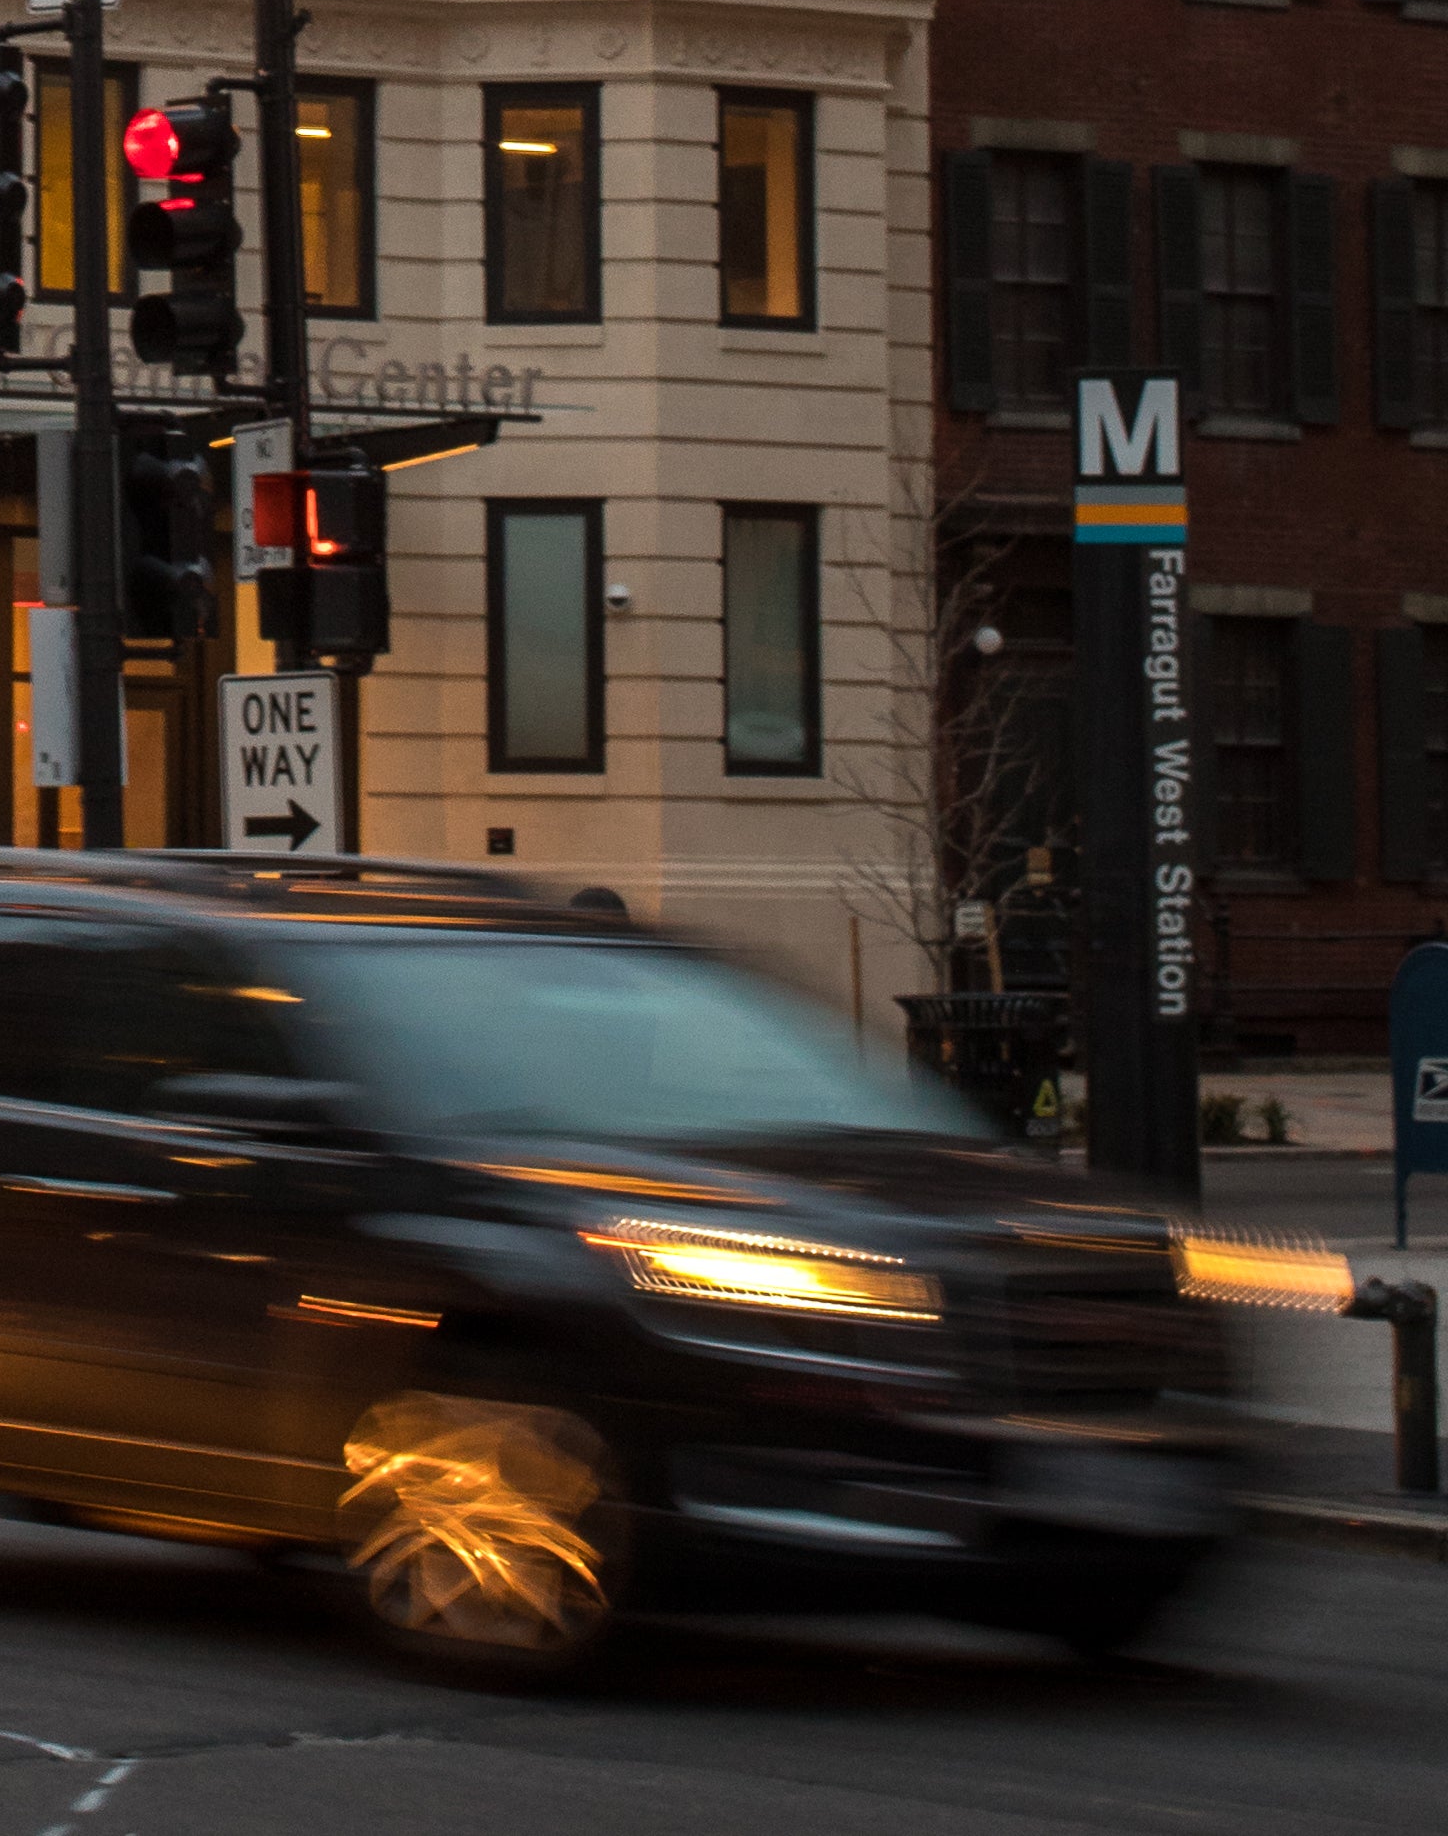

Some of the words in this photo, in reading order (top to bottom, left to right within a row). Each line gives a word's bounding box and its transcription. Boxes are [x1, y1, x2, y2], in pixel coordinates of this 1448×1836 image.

[318, 335, 544, 413] Center
[1077, 378, 1181, 476] M
[1143, 549, 1188, 722] Farragut
[242, 691, 317, 736] ONE
[240, 743, 320, 787] WAY
[1153, 739, 1191, 845] West
[1155, 864, 1195, 1016] Station
